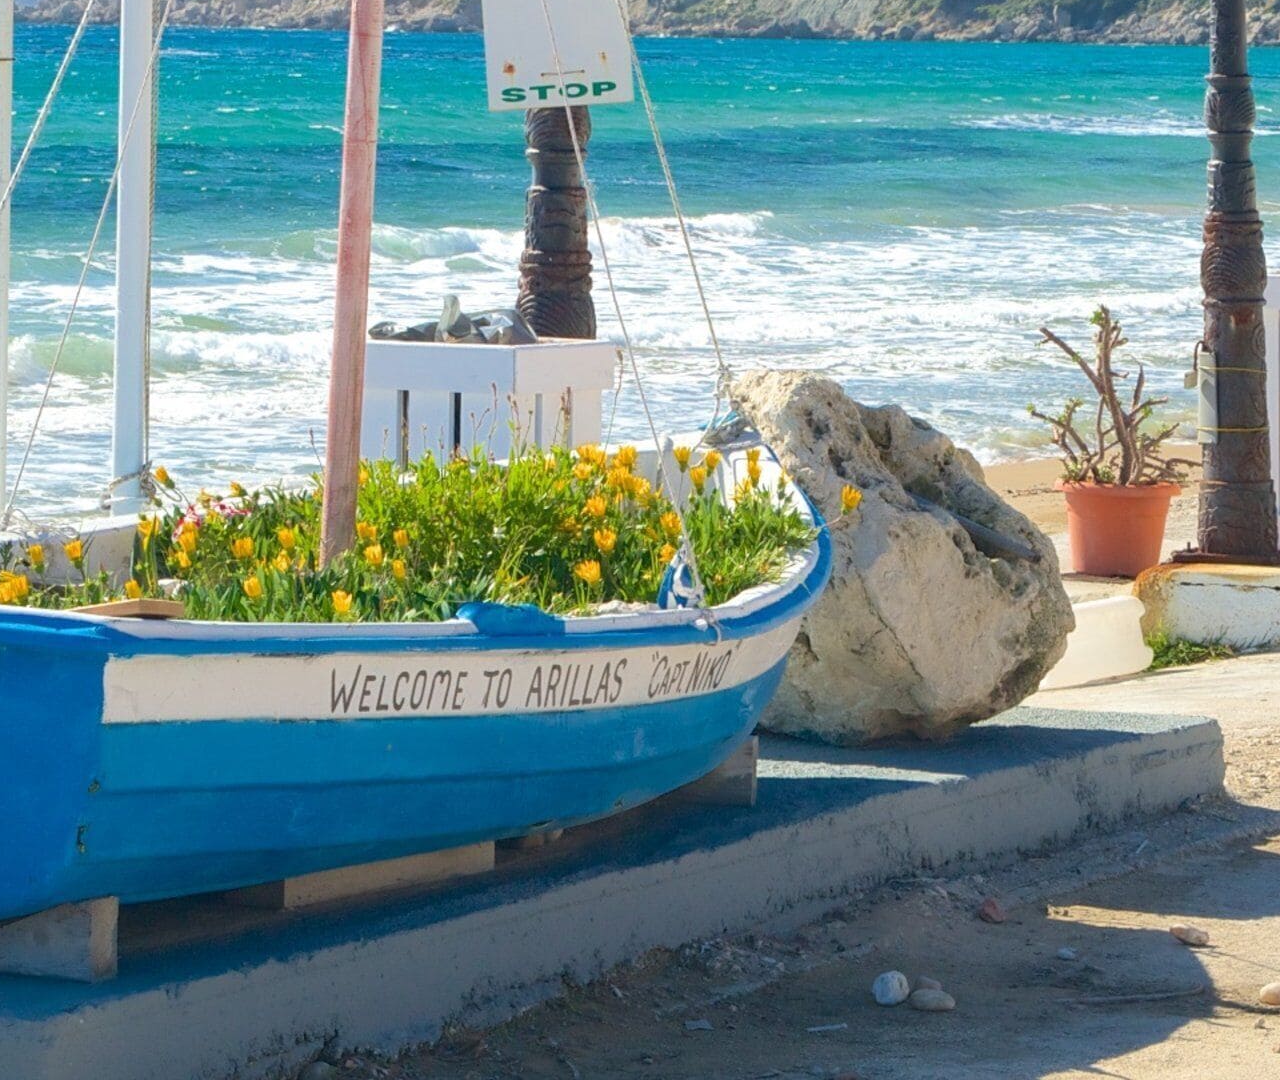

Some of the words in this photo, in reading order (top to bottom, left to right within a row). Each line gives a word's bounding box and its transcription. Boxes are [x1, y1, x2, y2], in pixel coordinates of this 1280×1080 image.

[501, 81, 617, 102] STOP
[331, 664, 468, 713] WELCOME
[483, 668, 514, 708] TO
[526, 658, 627, 707] ARILLAS
